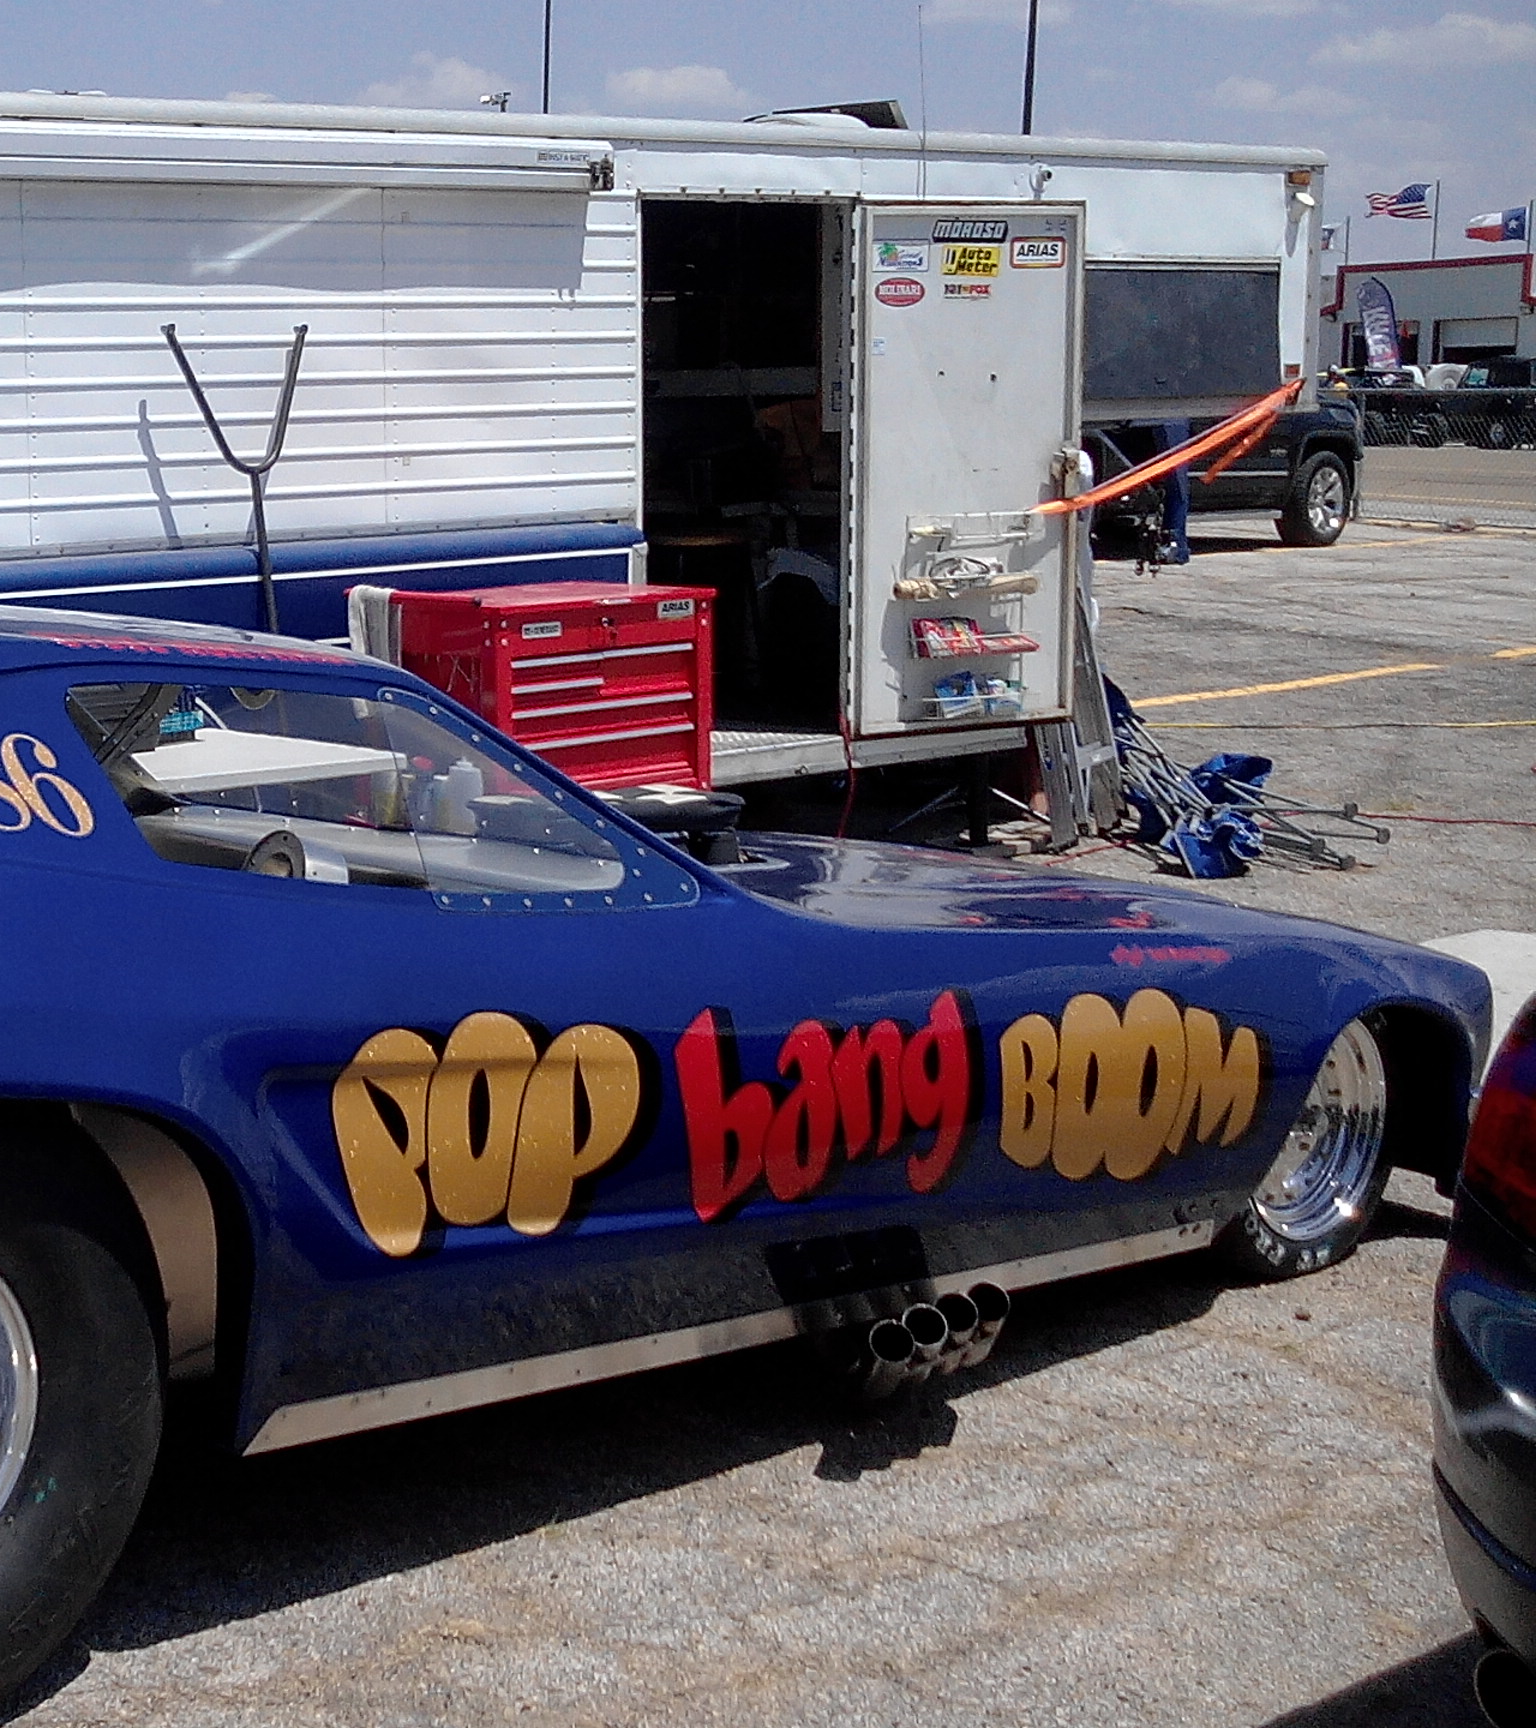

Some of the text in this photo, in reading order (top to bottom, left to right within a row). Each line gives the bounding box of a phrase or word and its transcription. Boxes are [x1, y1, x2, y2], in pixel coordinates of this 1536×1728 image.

[933, 221, 1007, 239] MOROSO
[958, 247, 992, 260] Auto
[1016, 243, 1059, 258] ARIAS
[955, 260, 998, 274] Meter
[332, 987, 1260, 1257] POP bang BOOM
